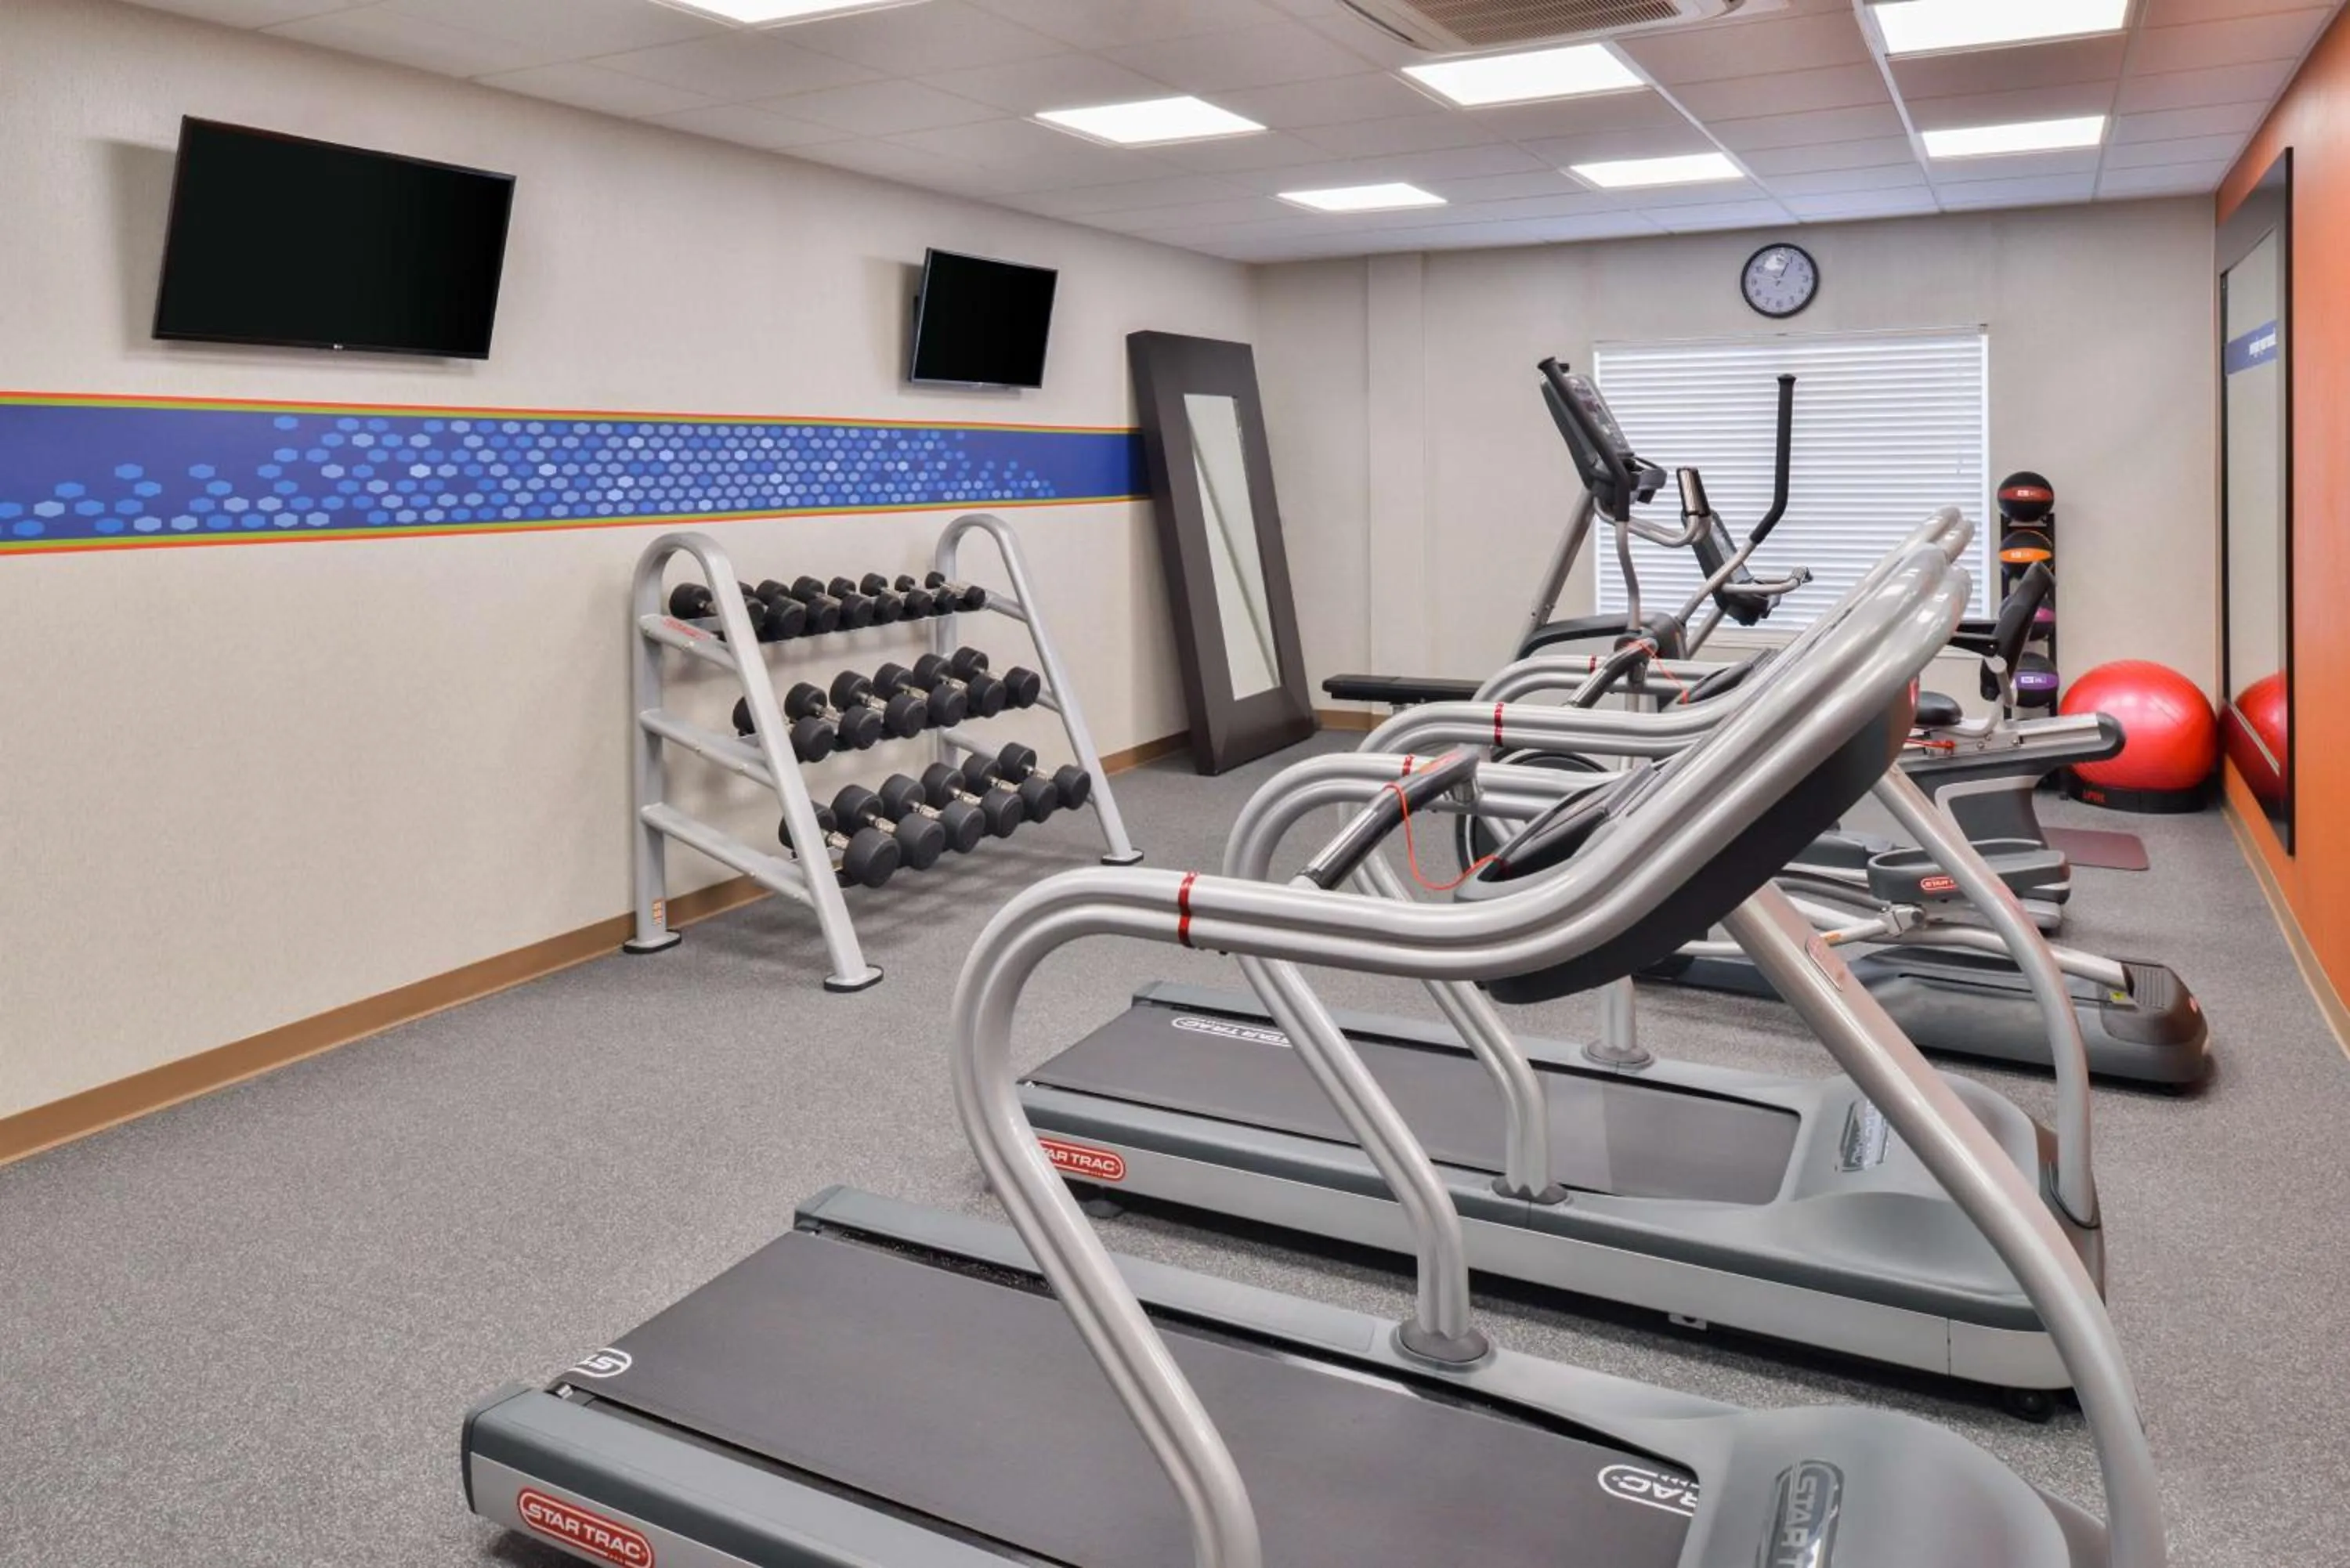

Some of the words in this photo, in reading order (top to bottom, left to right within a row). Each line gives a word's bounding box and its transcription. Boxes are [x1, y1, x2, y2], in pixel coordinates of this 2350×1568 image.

[1069, 1153, 1115, 1171] TRAC
[1618, 1476, 1698, 1508] RAC
[1781, 1476, 1817, 1547] STAR
[526, 1503, 579, 1535] STAR
[582, 1524, 641, 1559] TRAC
